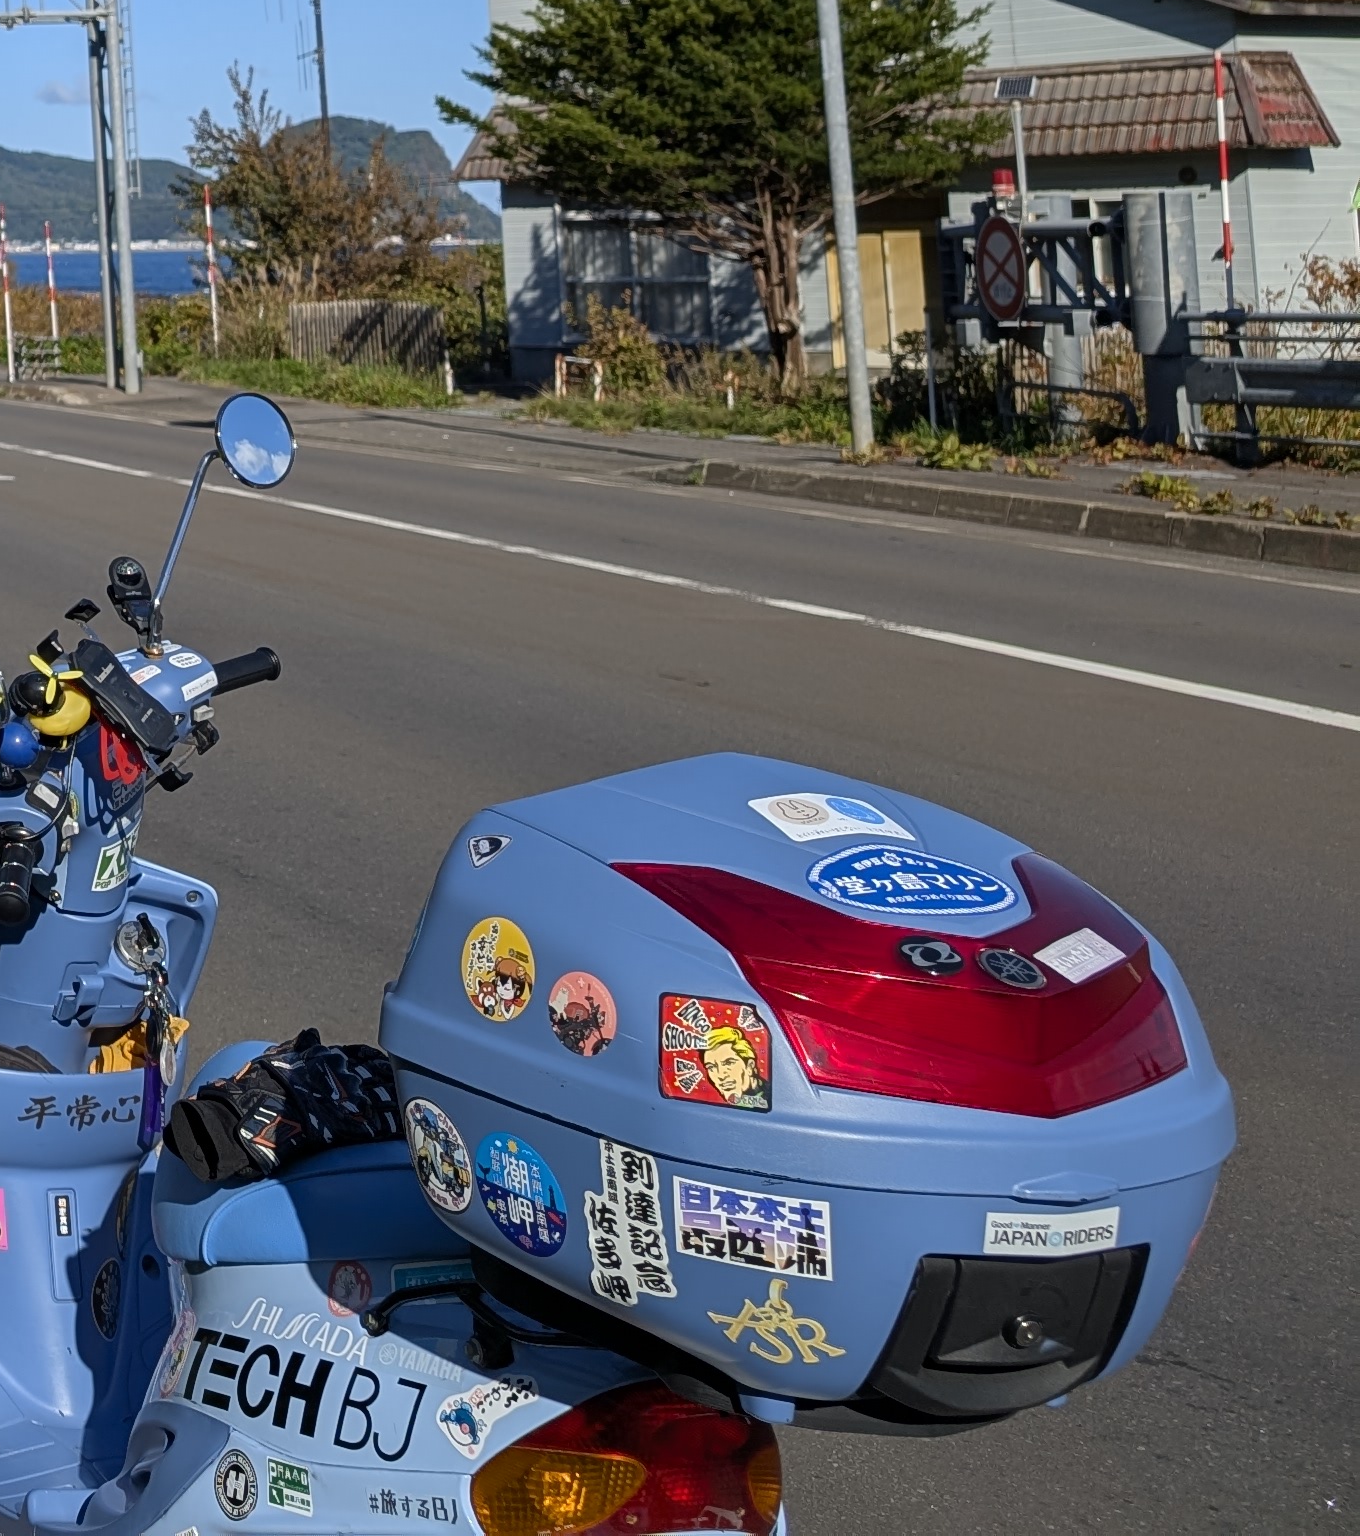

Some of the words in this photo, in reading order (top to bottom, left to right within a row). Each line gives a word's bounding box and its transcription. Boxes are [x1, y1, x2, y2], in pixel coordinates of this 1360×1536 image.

[17, 1094, 141, 1132] 平常心
[989, 1230, 1048, 1247] JAPAN
[1063, 1224, 1115, 1247] RIDERS
[990, 1220, 1013, 1229] Good
[1020, 1221, 1052, 1230] Manner
[399, 1347, 463, 1383] YAMAHA
[183, 1327, 335, 1438] TECH
[333, 1366, 428, 1462] BJ
